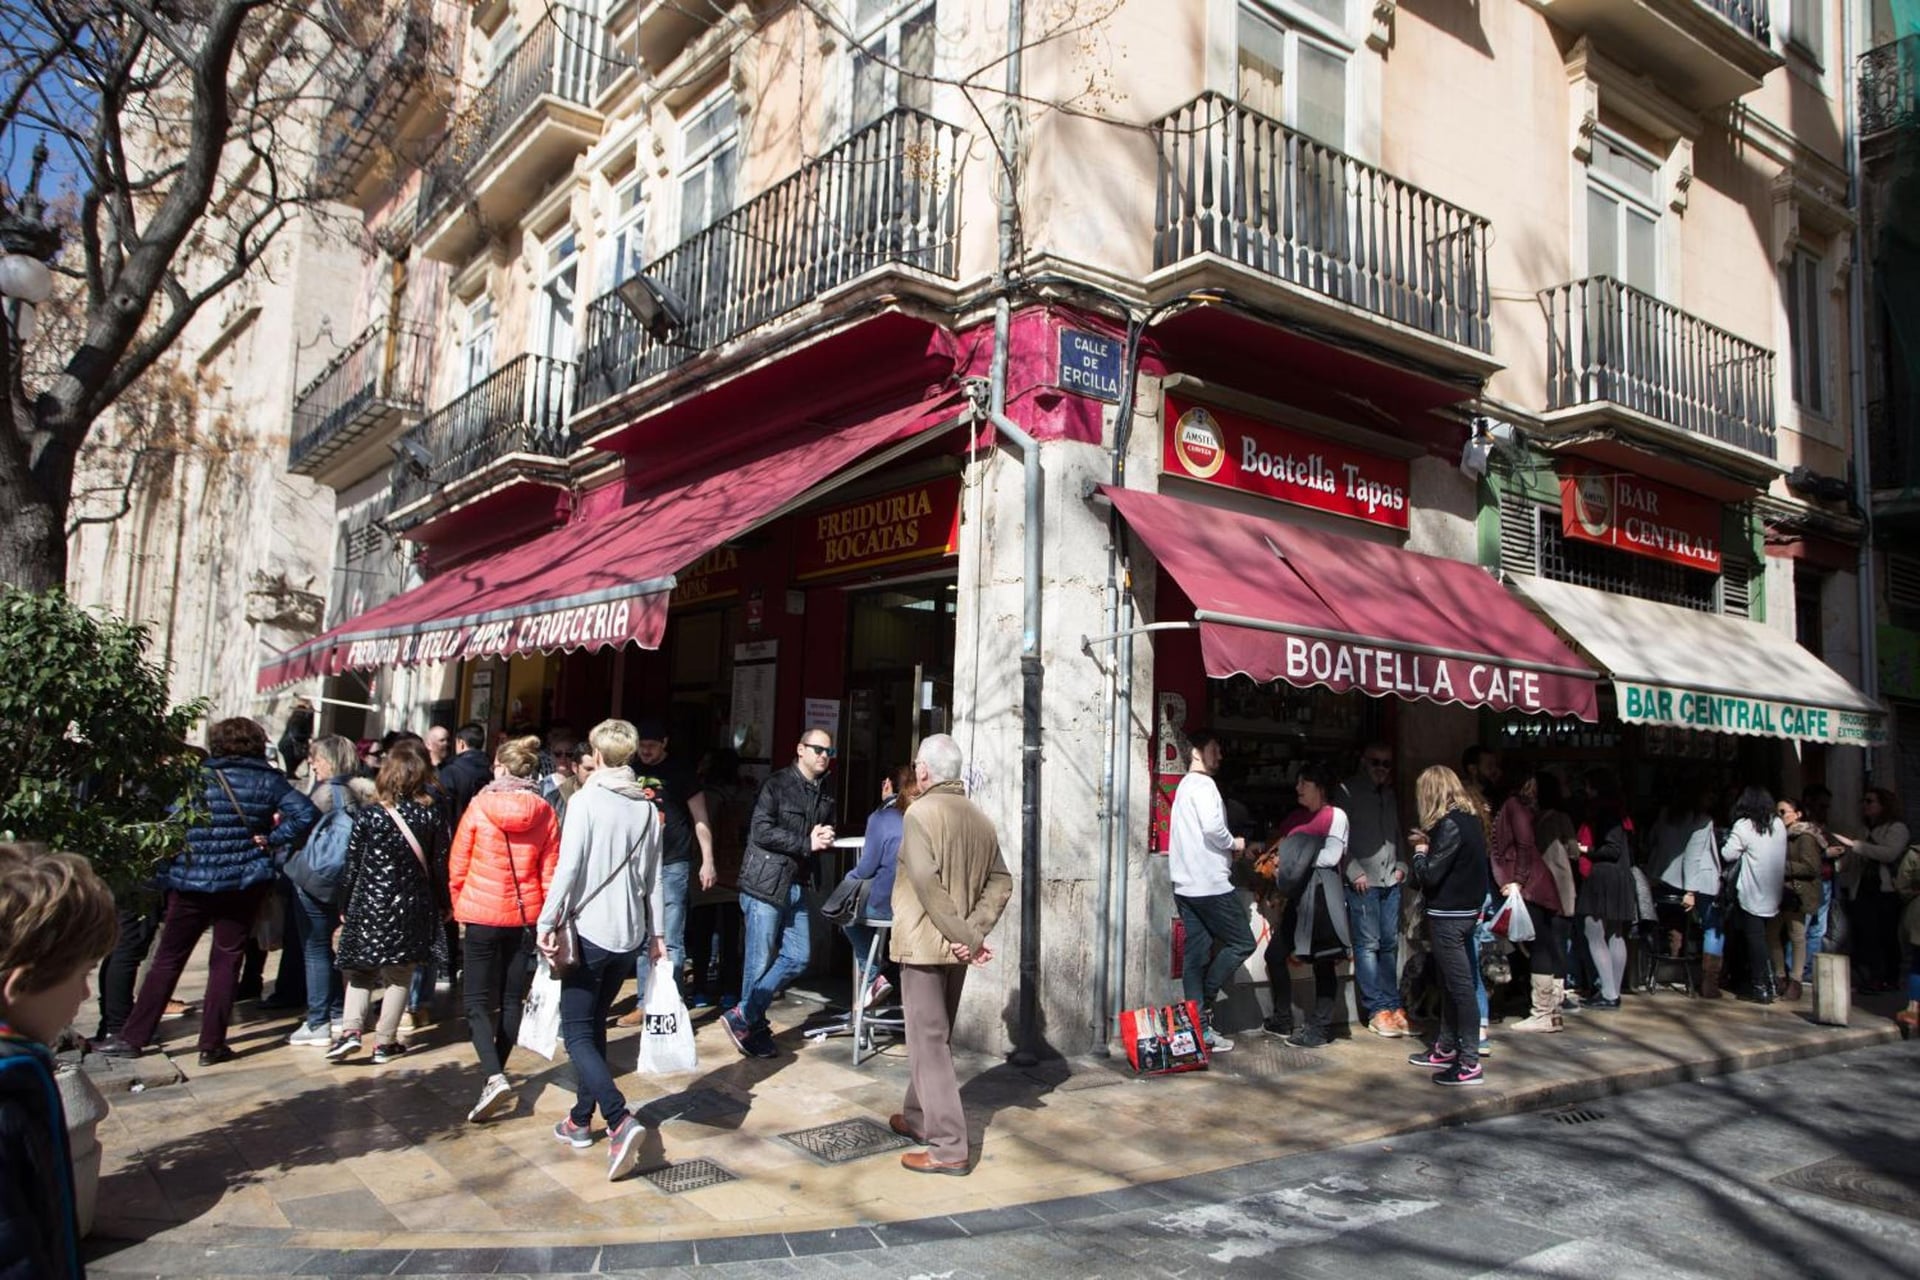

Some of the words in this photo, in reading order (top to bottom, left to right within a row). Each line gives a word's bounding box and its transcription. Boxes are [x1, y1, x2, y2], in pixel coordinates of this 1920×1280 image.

[1074, 337, 1108, 357] CALLE
[1083, 356, 1098, 369] DE
[1063, 365, 1117, 393] ERCILLA
[1185, 431, 1216, 446] AMSTEL
[1241, 435, 1336, 494] Boatella
[1343, 462, 1403, 513] Tapas
[817, 489, 932, 541] FREIDURIA
[1619, 484, 1659, 515] BAR
[824, 520, 919, 564] BOCATAS
[1625, 518, 1718, 562] CENTRAL
[516, 600, 631, 649] CERVECERIA
[1286, 637, 1455, 697] BOATELLA
[1469, 664, 1541, 707] CAFE
[1626, 686, 1674, 722] BAR
[1679, 692, 1776, 732] CENTRAL
[1780, 706, 1829, 737] CAFE
